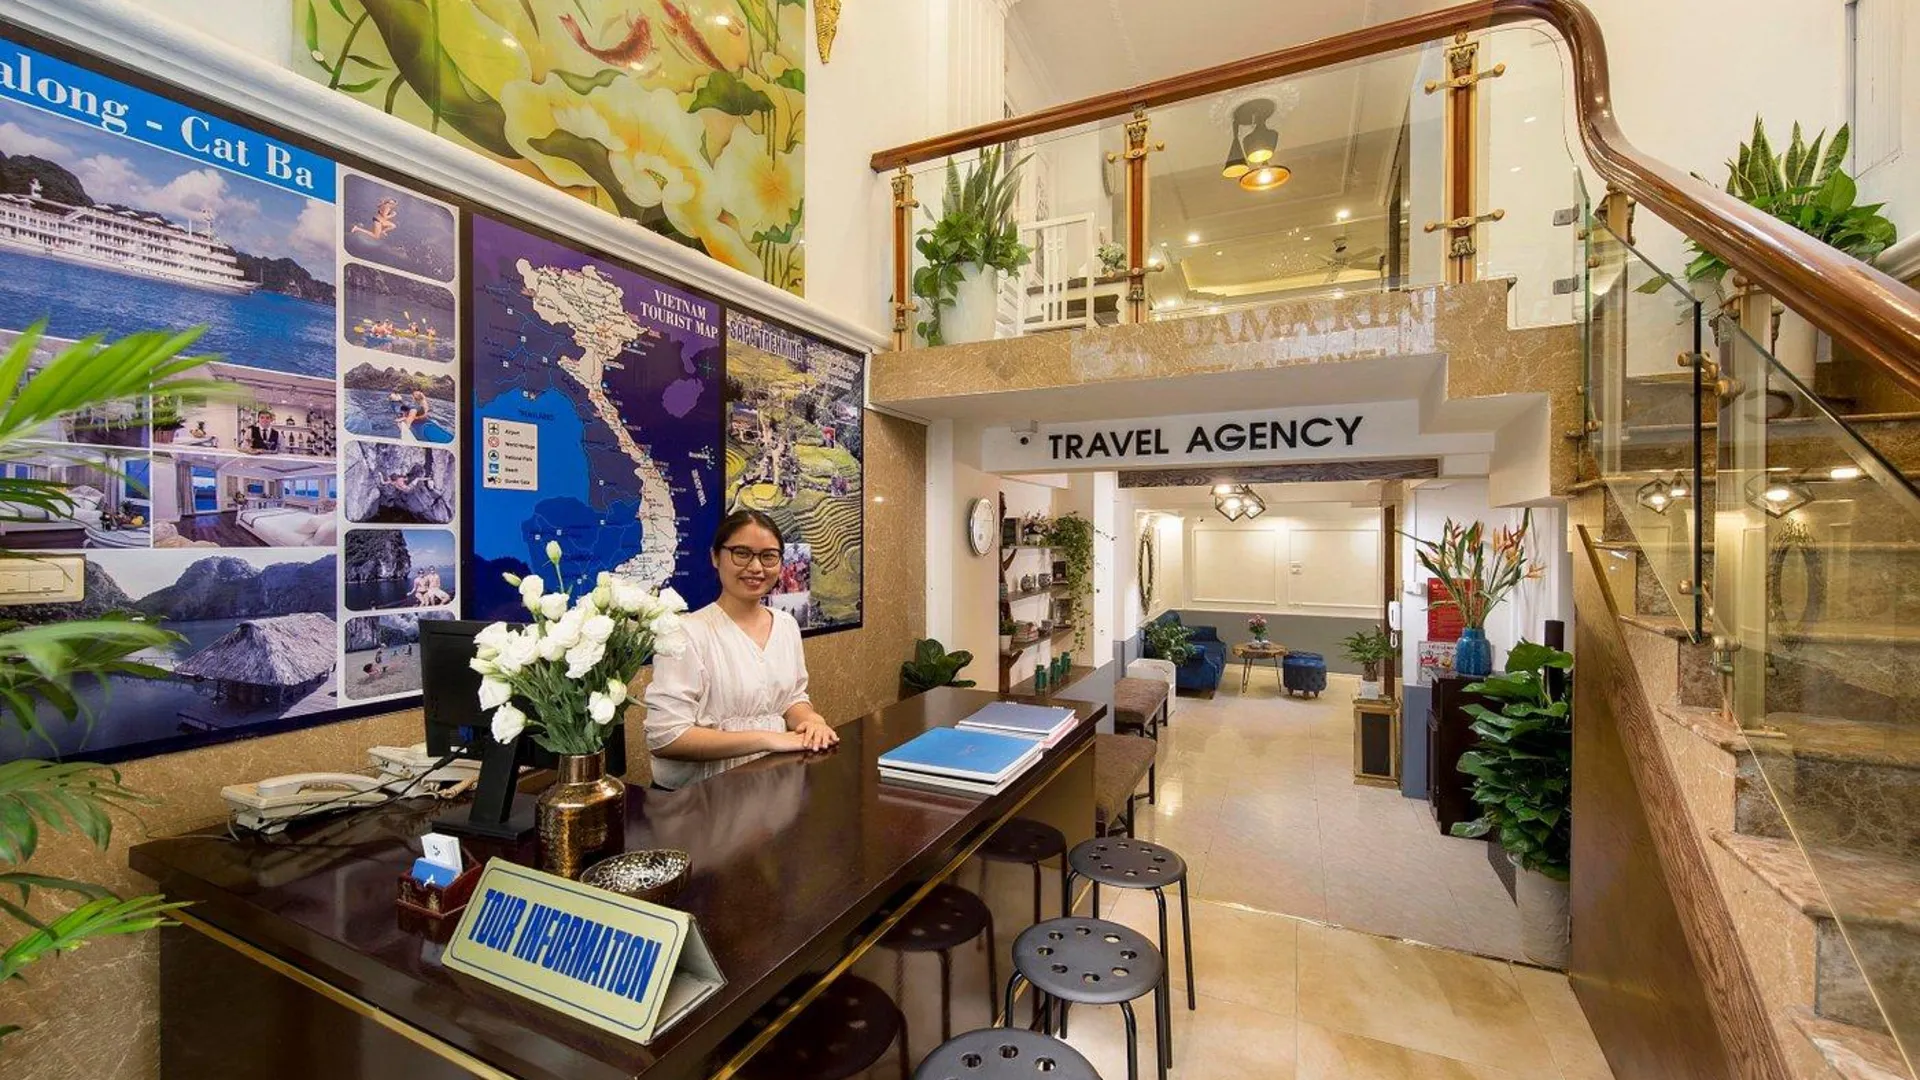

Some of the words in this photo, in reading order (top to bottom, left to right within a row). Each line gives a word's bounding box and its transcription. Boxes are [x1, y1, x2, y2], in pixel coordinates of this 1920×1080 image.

[180, 115, 250, 168] Cat
[265, 142, 314, 189] Ba
[639, 301, 692, 331] TOURIST
[696, 322, 719, 340] MAP
[654, 289, 707, 320] VIETNAM
[730, 320, 758, 348] SAPA
[1048, 428, 1169, 459] TRAVEL
[1185, 416, 1364, 454] AGENCY
[468, 888, 528, 953] TOUR
[513, 903, 662, 1004] INFORMATION
